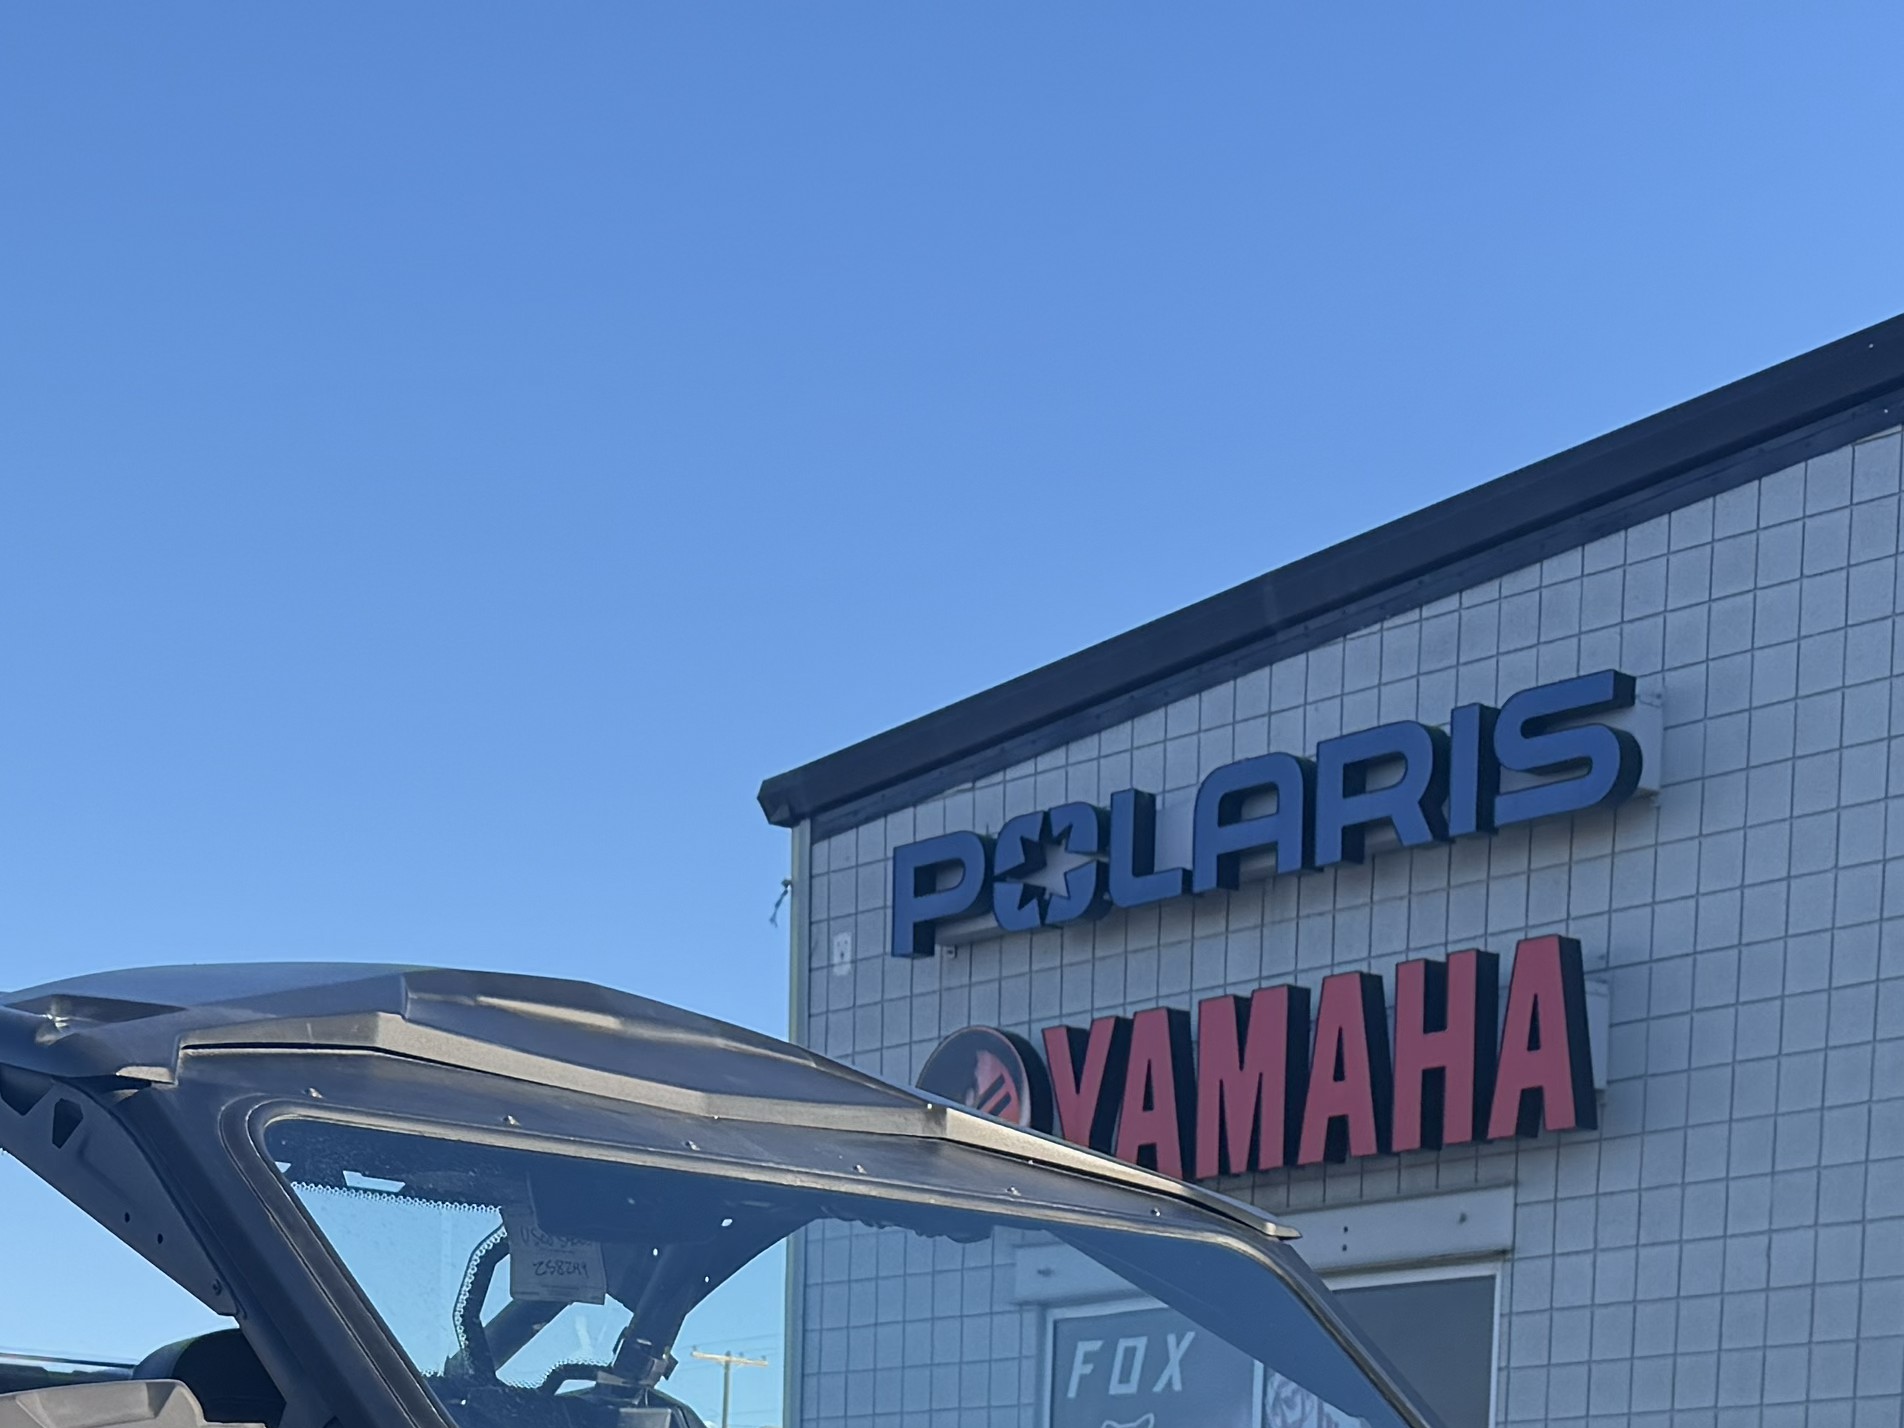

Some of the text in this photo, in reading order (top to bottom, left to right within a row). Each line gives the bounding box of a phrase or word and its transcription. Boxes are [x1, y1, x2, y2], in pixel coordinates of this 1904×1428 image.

[892, 668, 1641, 958] POLARIS
[1042, 933, 1594, 1180] YAMAHA
[1066, 1331, 1196, 1399] FOX
